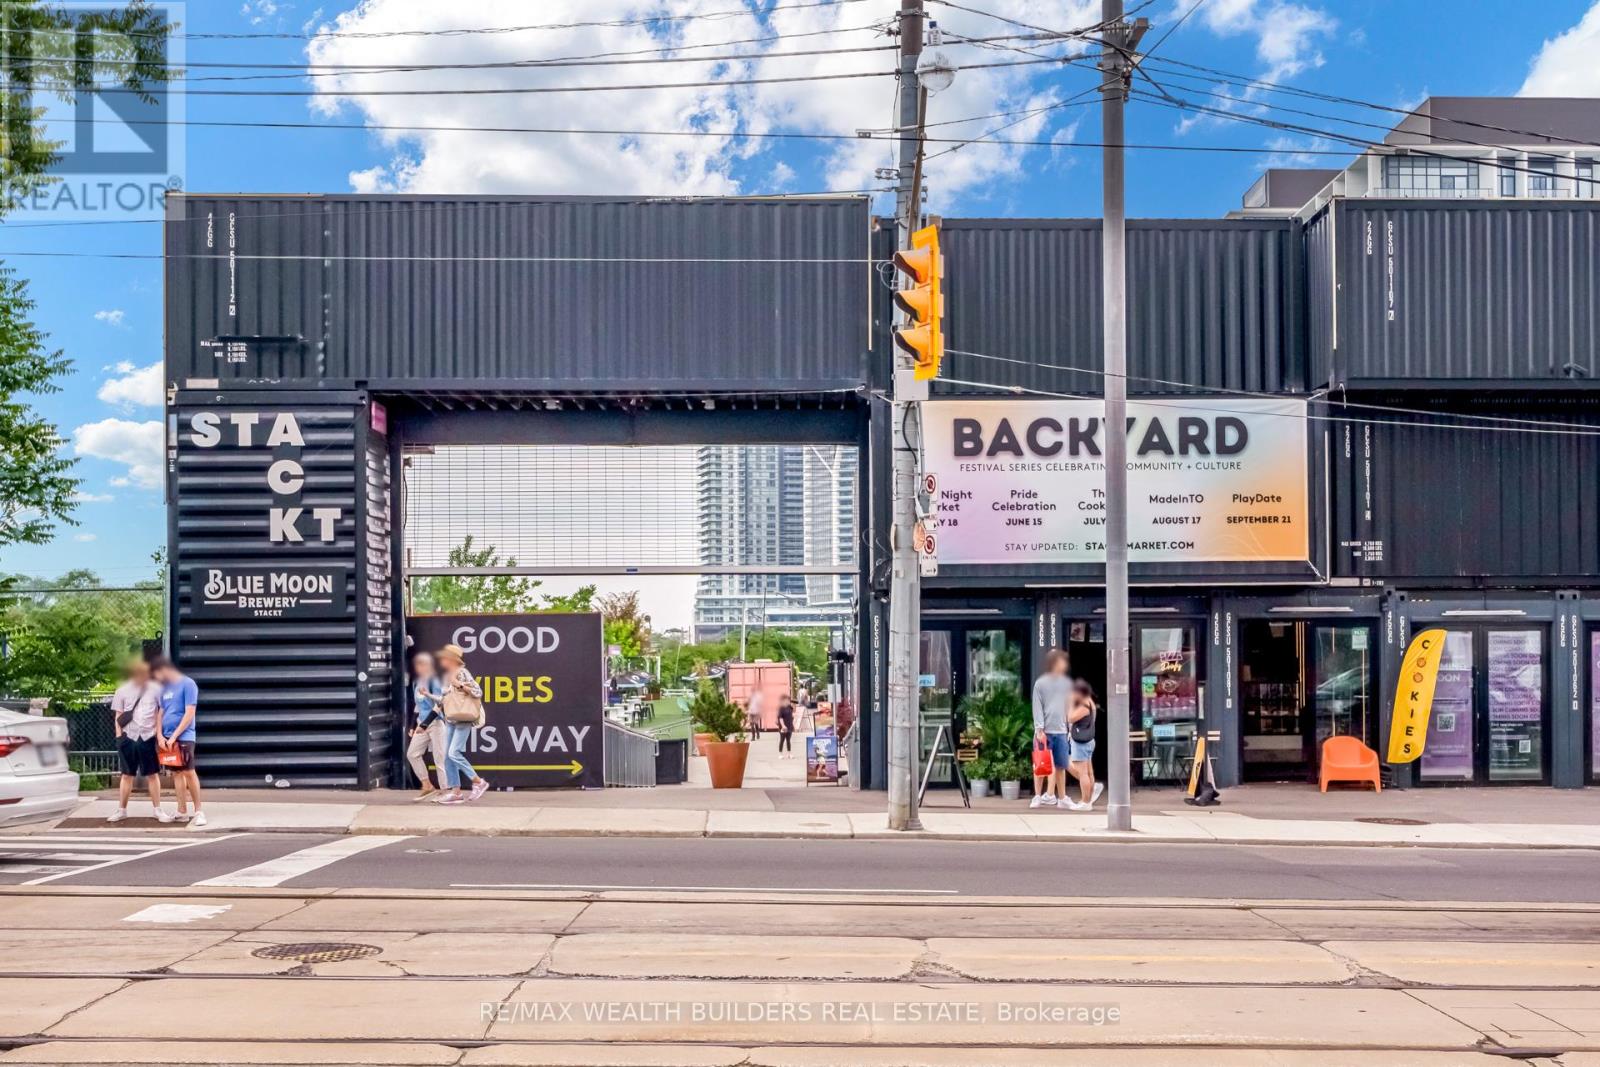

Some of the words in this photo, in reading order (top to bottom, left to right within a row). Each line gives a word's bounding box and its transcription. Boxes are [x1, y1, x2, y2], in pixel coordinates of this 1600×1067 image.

[960, 463, 1005, 472] FESTIVAL
[1009, 463, 1042, 472] SERIES
[1046, 462, 1106, 471] CELEBRATIN
[1126, 462, 1182, 471] OMMUNITY
[1195, 461, 1242, 470] CULTURE
[941, 490, 973, 502] Night
[1010, 489, 1038, 499] Pride
[1092, 489, 1105, 498] Th
[1150, 494, 1204, 504] MadeInTO
[1232, 494, 1282, 506] PlayDate
[937, 503, 960, 512] rket
[992, 501, 1056, 511] Celebration
[1078, 501, 1105, 510] Cook
[948, 519, 958, 527] 18
[1005, 518, 1030, 526] JUNE
[1033, 518, 1042, 526] 15
[1083, 517, 1106, 525] JULY
[1152, 517, 1189, 525] AUGUST
[1192, 516, 1201, 524] 17
[1226, 515, 1279, 524] SEPTEMBER
[1281, 515, 1291, 523] 21
[1005, 543, 1027, 551] STAY
[1031, 542, 1078, 551] UPDATED:
[1085, 541, 1194, 550] STAMARKET.COM
[204, 569, 264, 599] BLUE
[270, 573, 333, 594] MOON
[238, 596, 298, 608] BREWERY
[452, 626, 560, 654] GOOD
[1438, 674, 1460, 682] OON
[474, 676, 553, 703] IBES
[508, 726, 591, 752] WAY
